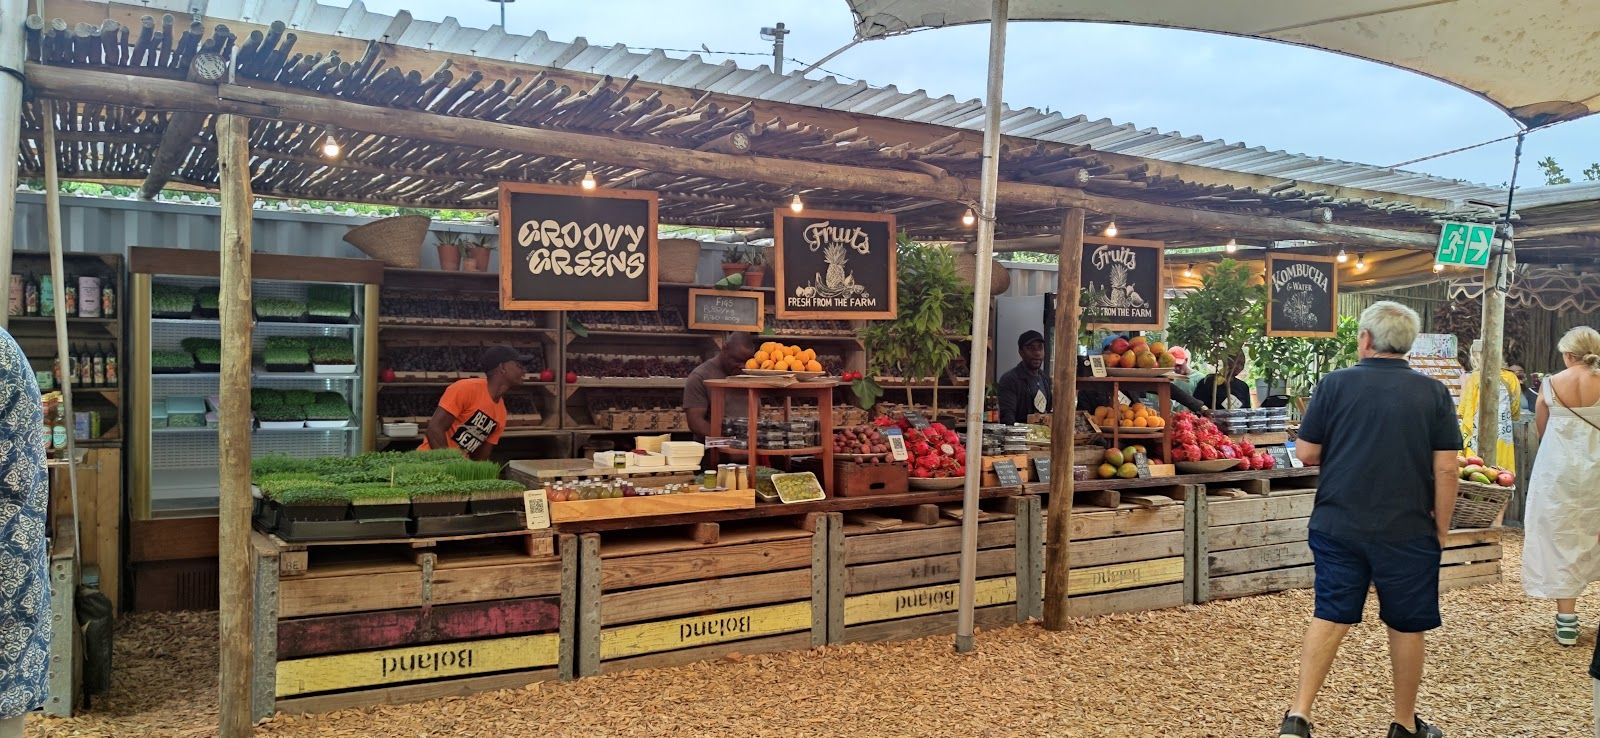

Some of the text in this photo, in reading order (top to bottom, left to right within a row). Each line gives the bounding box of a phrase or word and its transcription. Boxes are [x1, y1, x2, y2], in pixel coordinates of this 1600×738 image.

[518, 219, 645, 252] GROOVY
[803, 221, 870, 254] Fruits
[528, 248, 645, 279] GREENS
[1091, 245, 1136, 270] Fruits
[1272, 263, 1329, 293] KOMBUCHA
[787, 297, 876, 307] FRESH FROM THE FARM
[1117, 308, 1130, 317] THE
[1131, 308, 1152, 317] FARM
[894, 590, 955, 613] Boland
[680, 615, 751, 642] Boland
[382, 648, 473, 678] Boland
